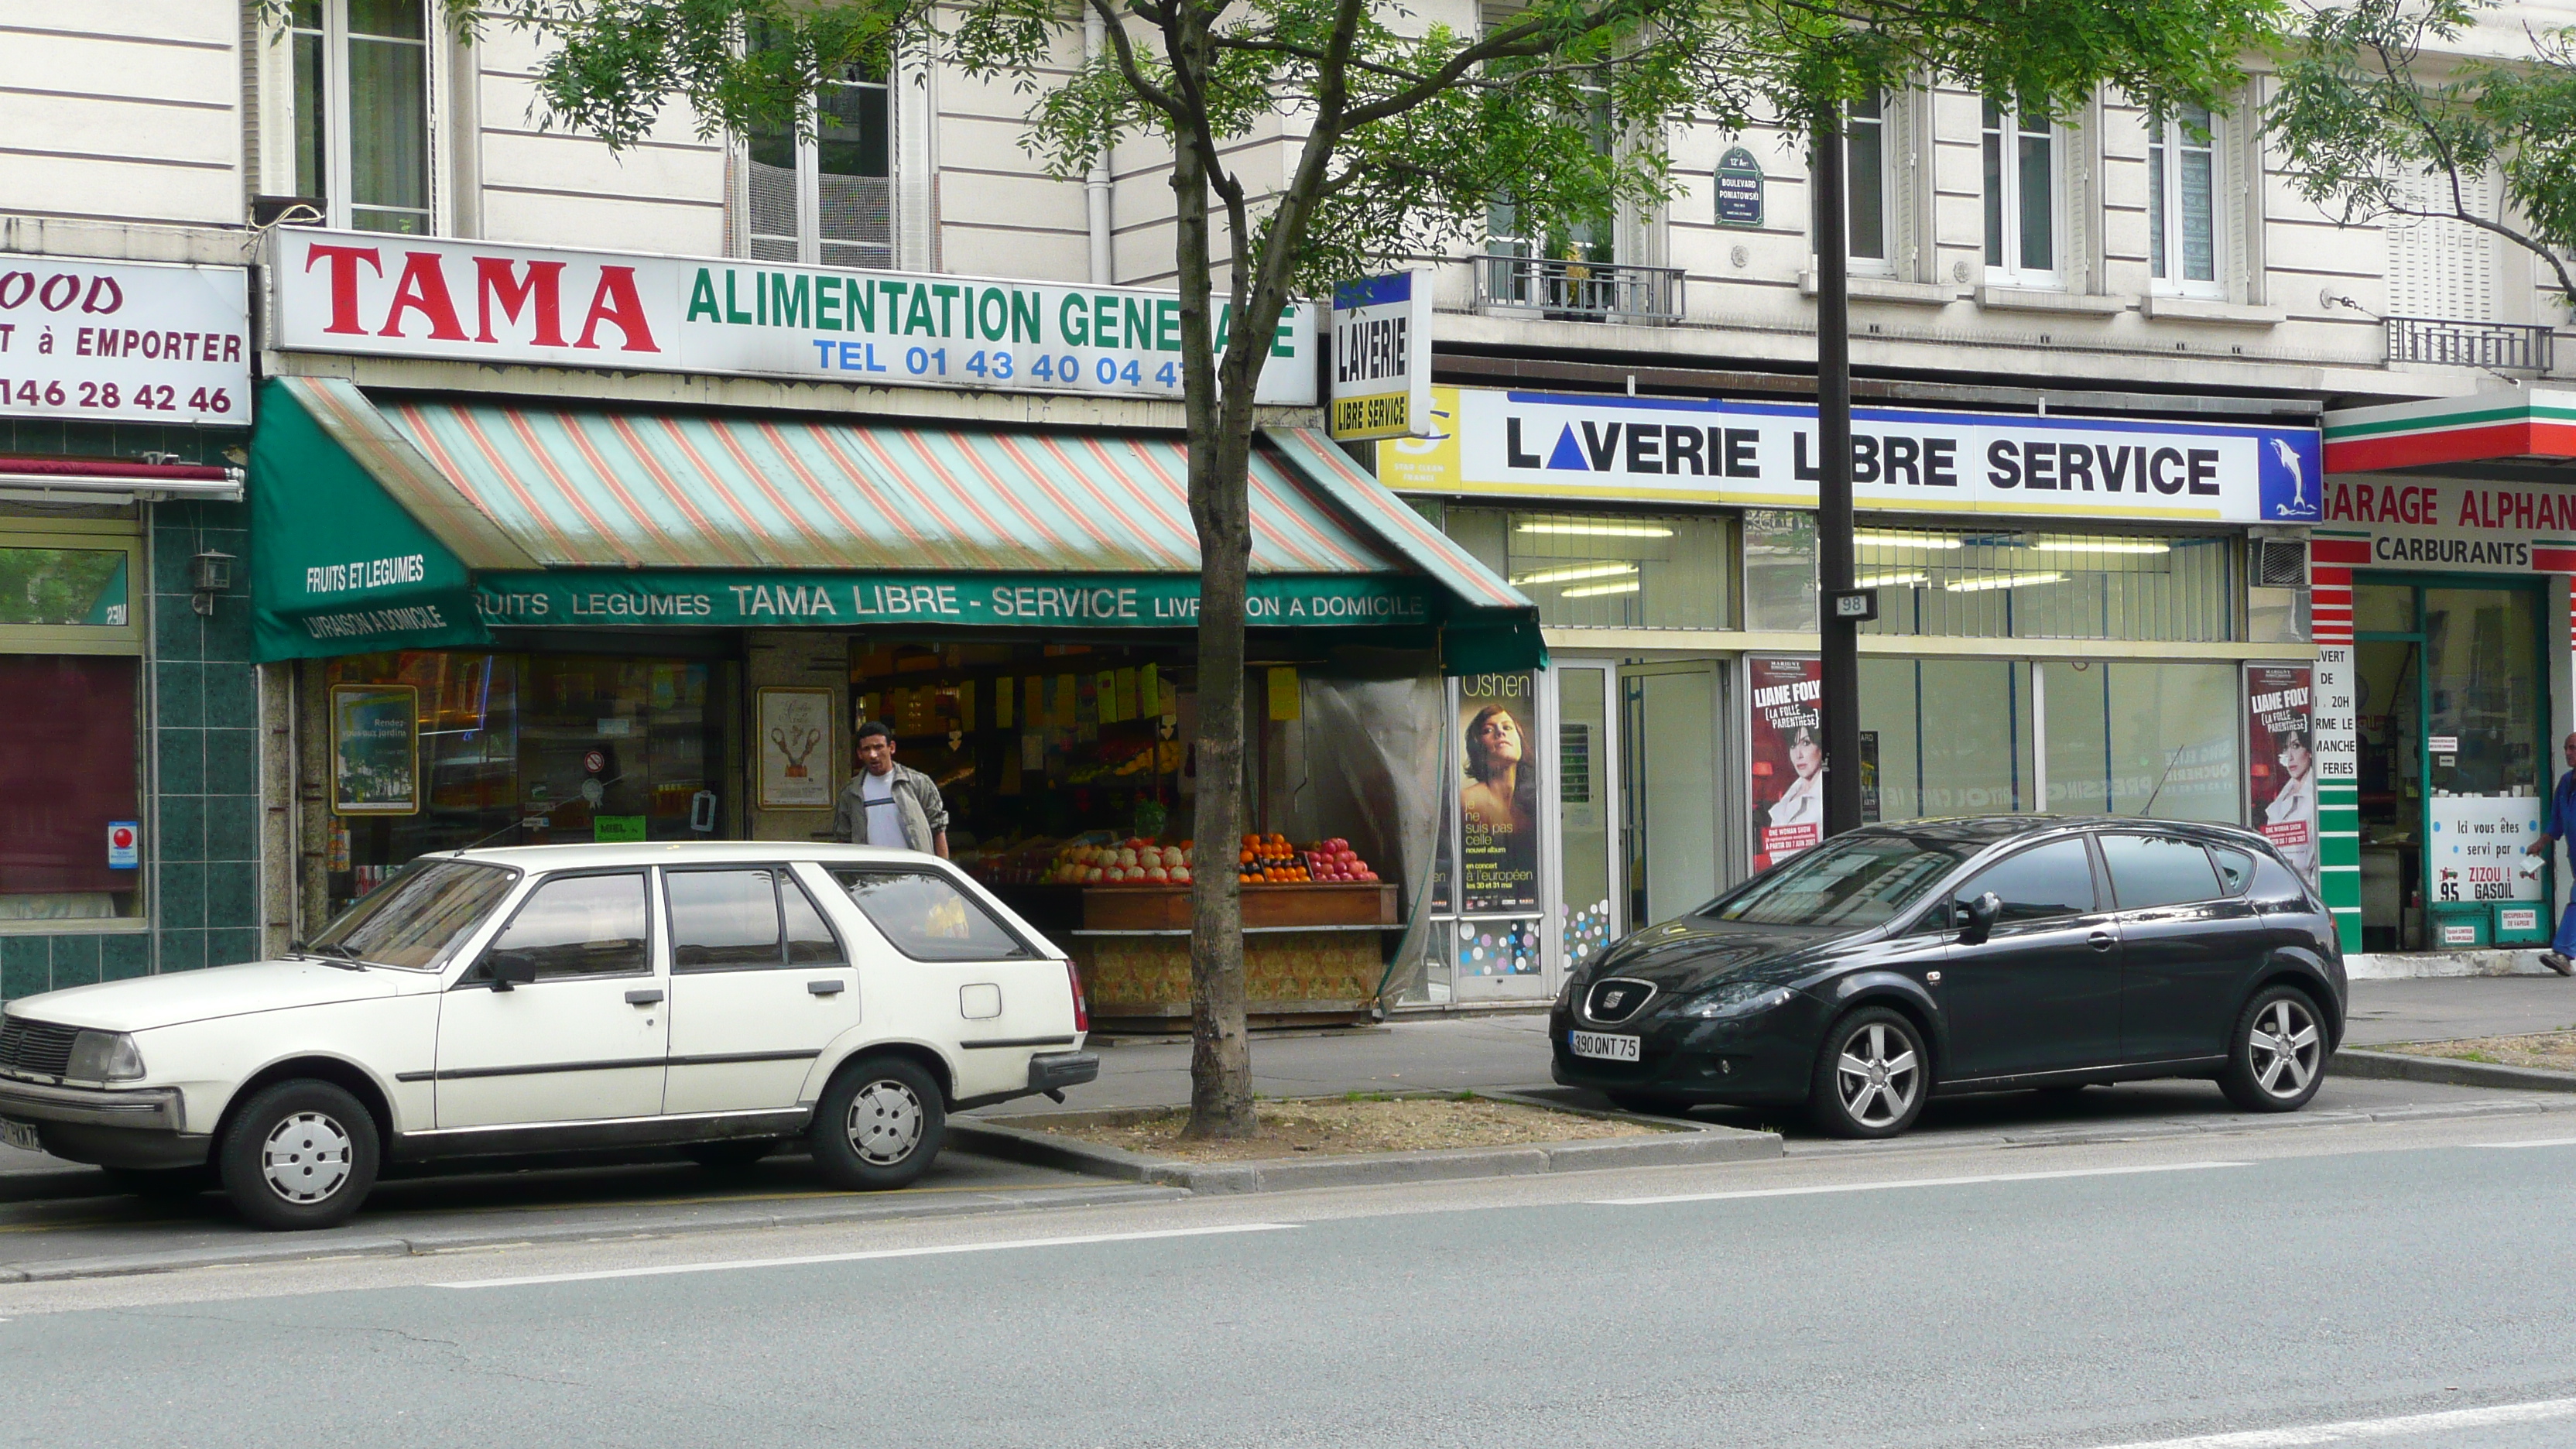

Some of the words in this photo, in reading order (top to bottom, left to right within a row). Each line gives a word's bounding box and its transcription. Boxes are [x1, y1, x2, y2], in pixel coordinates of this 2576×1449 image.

[1721, 178, 1756, 188] BOULEVARD
[1719, 190, 1759, 200] PONIATOWSKI
[304, 242, 662, 353] TAMA
[686, 267, 1041, 345] ALIMENTATION
[1058, 292, 1296, 358] GENEAE
[38, 324, 53, 355] à
[75, 327, 242, 363] EMPORTER
[1338, 317, 1406, 383] LAVERIE
[812, 338, 886, 373] TEL
[906, 345, 947, 376] 01
[965, 349, 1013, 380] 43
[1031, 354, 1080, 383] 40
[1096, 356, 1142, 388] 04
[1155, 361, 1184, 389] 4
[78, 380, 121, 409] 28
[133, 383, 176, 412] 42
[188, 385, 231, 414] 46
[1338, 400, 1364, 431] LIBRE
[1367, 396, 1406, 429] SERVICE
[1506, 416, 1761, 478] LAVERIE
[1793, 430, 1958, 488] LBRE
[1986, 438, 2221, 496] SERVICE
[1395, 462, 1415, 471] STAR
[1418, 464, 1445, 472] CLEAN
[1403, 473, 1435, 482] FRANCE
[2376, 536, 2528, 566] CARBURANTS
[306, 564, 345, 593] FRUITS
[349, 562, 365, 589] ET
[366, 553, 424, 587] LEGUMES
[471, 593, 550, 615] RUITS
[573, 593, 711, 616] LEGUMES
[728, 584, 837, 616] TAMA
[852, 585, 961, 615] LIBRE
[992, 586, 1138, 618] SERVICE
[1289, 597, 1306, 617] A
[1312, 595, 1424, 616] DOMICILE
[1842, 596, 1861, 611] 98
[303, 610, 369, 639] LIVRAISON
[368, 611, 387, 633] A
[378, 605, 448, 632] DOMICILE
[2321, 673, 2334, 685] DE
[1754, 683, 1792, 708] LIANE
[1791, 679, 1821, 703] FOLY
[2251, 691, 2283, 714] LIANE
[2283, 686, 2308, 708] FOLY
[2331, 696, 2349, 708] 20H
[1779, 704, 1801, 717] FOLLE
[2273, 709, 2291, 722] FOLLE
[2315, 718, 2337, 730] RME
[2342, 718, 2353, 730] LE
[2323, 762, 2354, 775] FERIES
[1465, 812, 1480, 821] ne
[1465, 821, 1488, 834] suis
[1492, 824, 1513, 835] pas
[2458, 820, 2468, 834] Ici
[2474, 824, 2495, 834] vous
[2500, 817, 2519, 834] êtes
[1465, 834, 1492, 845] celle
[2467, 841, 2490, 855] servi
[2496, 844, 2511, 859] par
[1476, 868, 1533, 882] l'européen
[2468, 867, 2501, 882] ZIZOU
[2440, 882, 2460, 902] 95
[2475, 882, 2515, 900] GASOIL
[1575, 1034, 1594, 1053] 390
[1595, 1036, 1617, 1056] QNT
[1619, 1039, 1636, 1057] 75
